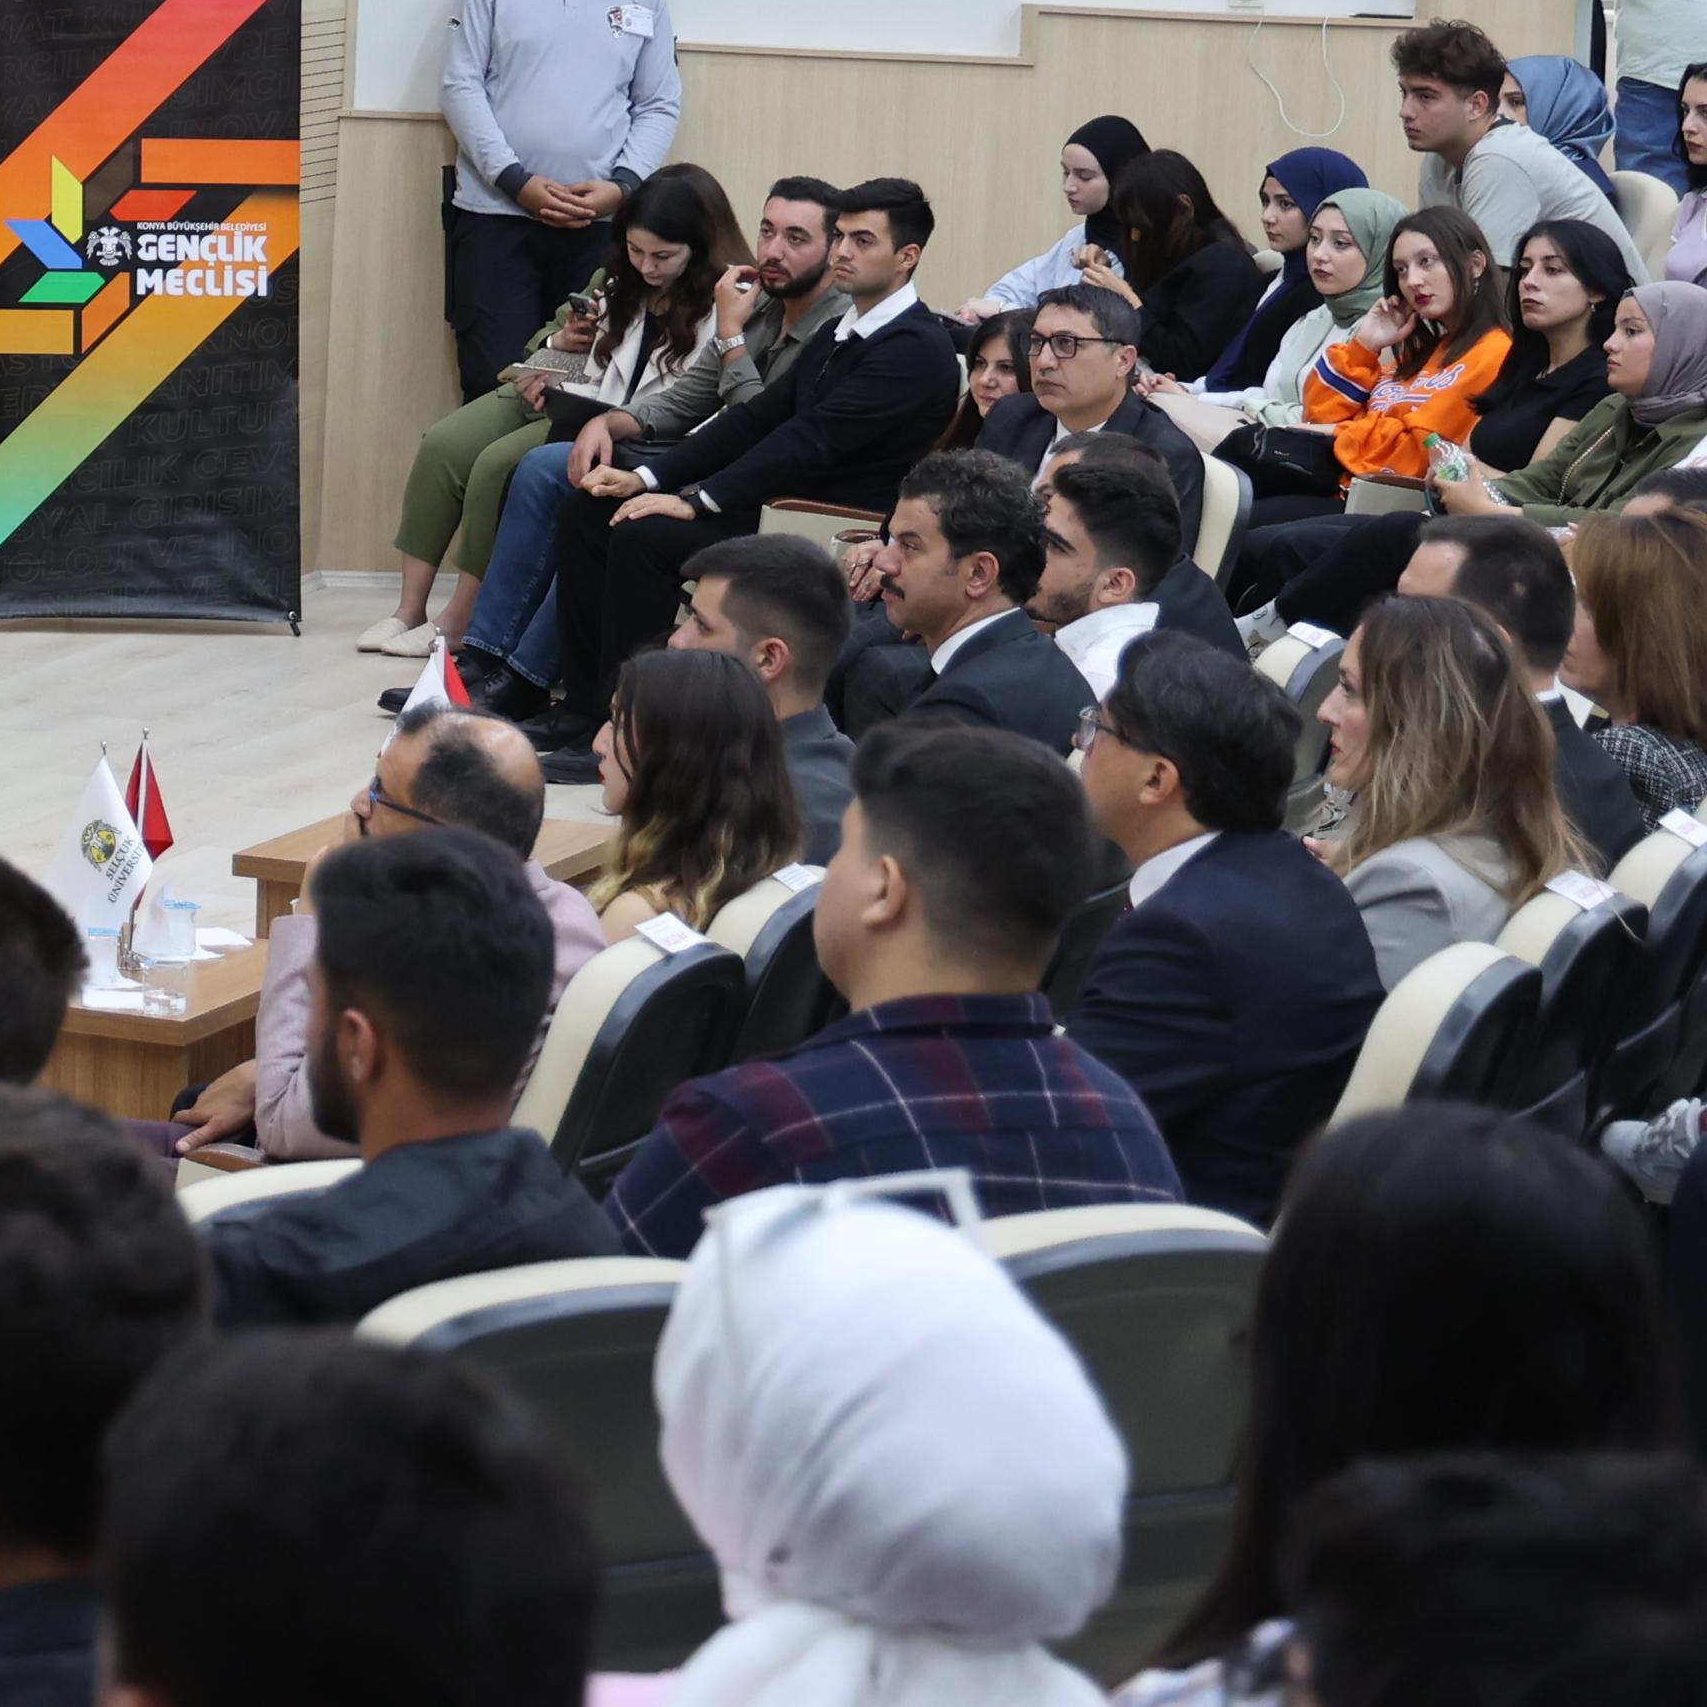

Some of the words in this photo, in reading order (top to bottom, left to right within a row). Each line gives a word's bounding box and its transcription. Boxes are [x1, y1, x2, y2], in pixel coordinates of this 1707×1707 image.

[136, 222, 166, 231] KONYA
[167, 221, 220, 233] BÜYÜKŞEHİR
[136, 231, 268, 267] GENÇLİK
[136, 265, 268, 297] MECLİSİ
[105, 835, 134, 881] SELÇUK
